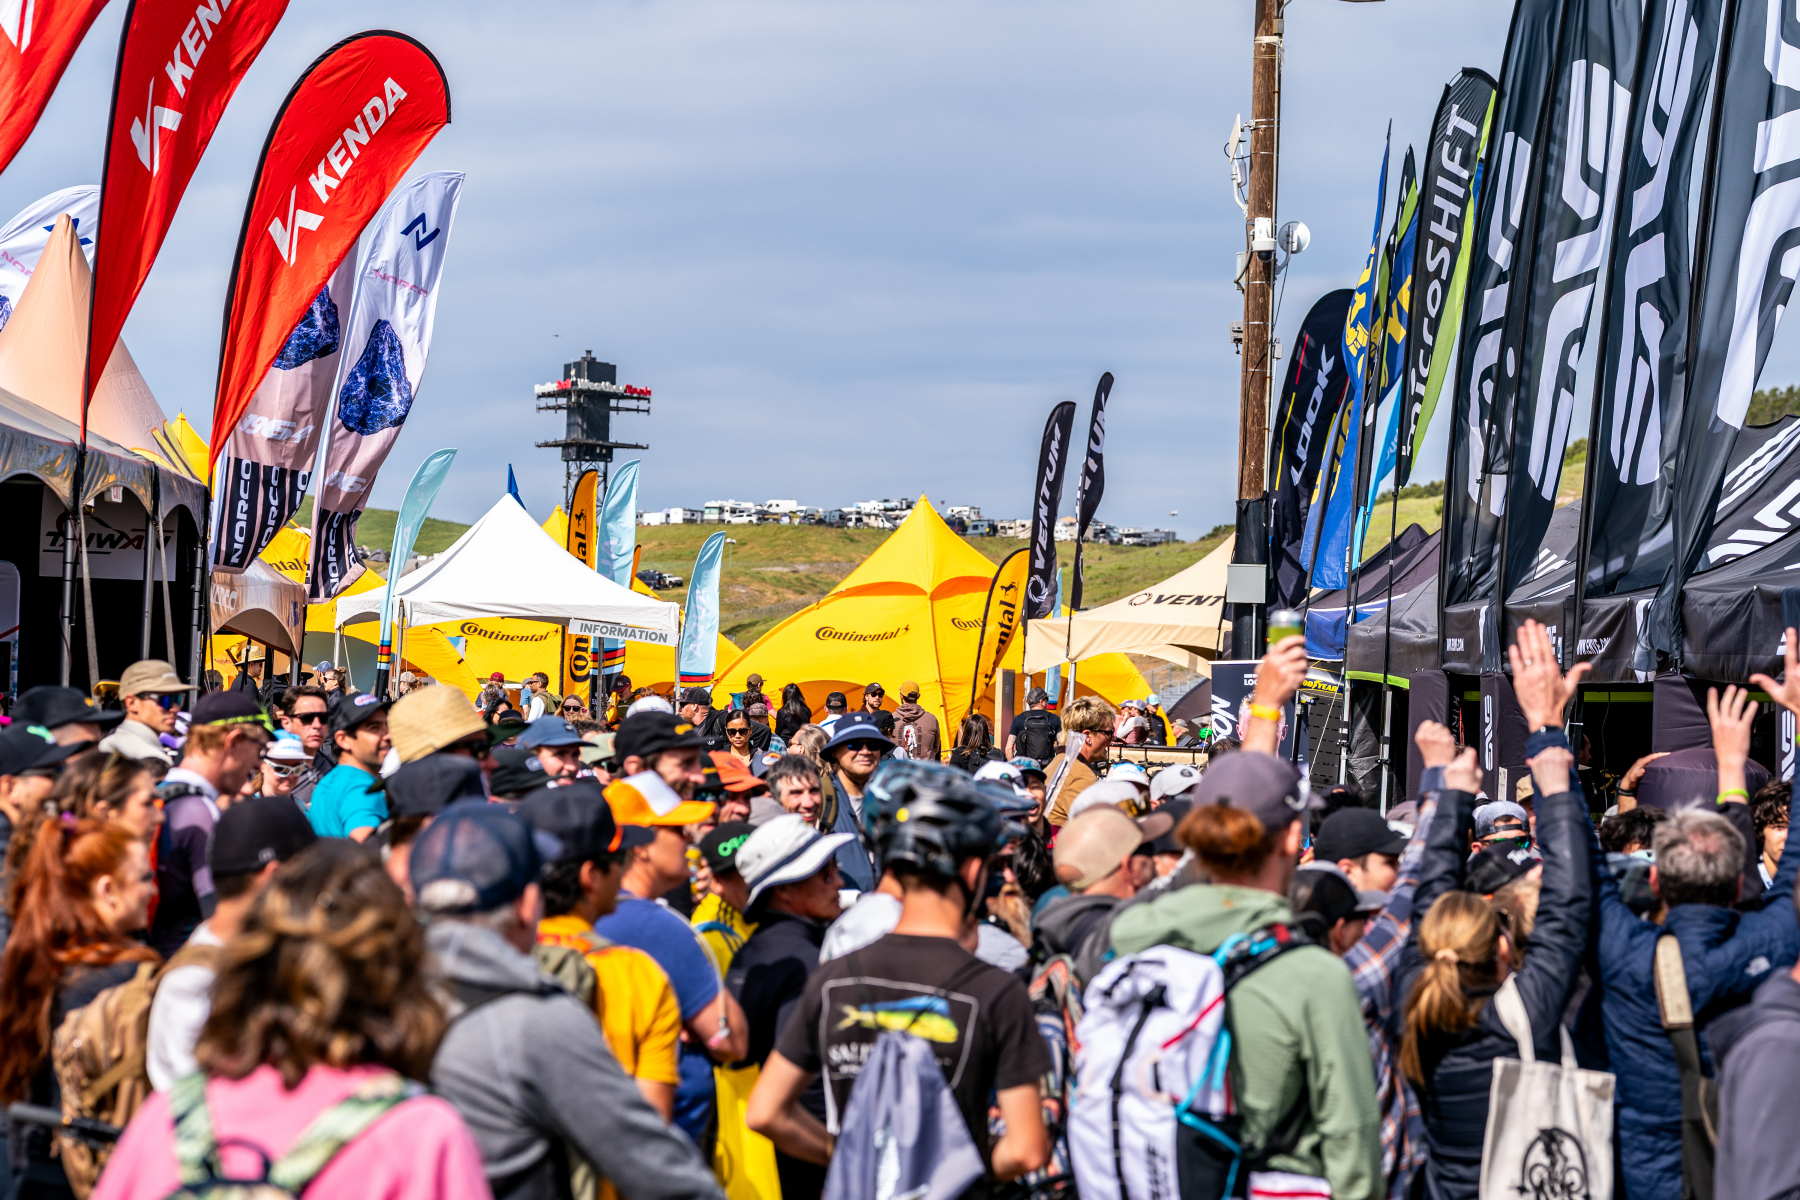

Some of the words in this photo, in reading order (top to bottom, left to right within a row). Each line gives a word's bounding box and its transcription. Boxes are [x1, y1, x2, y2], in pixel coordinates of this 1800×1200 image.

[165, 0, 232, 99] KEN
[308, 76, 408, 204] KENDA
[1290, 343, 1336, 487] LOOK
[231, 459, 252, 564] NORCO
[1035, 421, 1062, 569] VENTUM
[460, 622, 549, 642] Continental
[579, 622, 668, 643] INFORMATION
[815, 626, 900, 642] Continental
